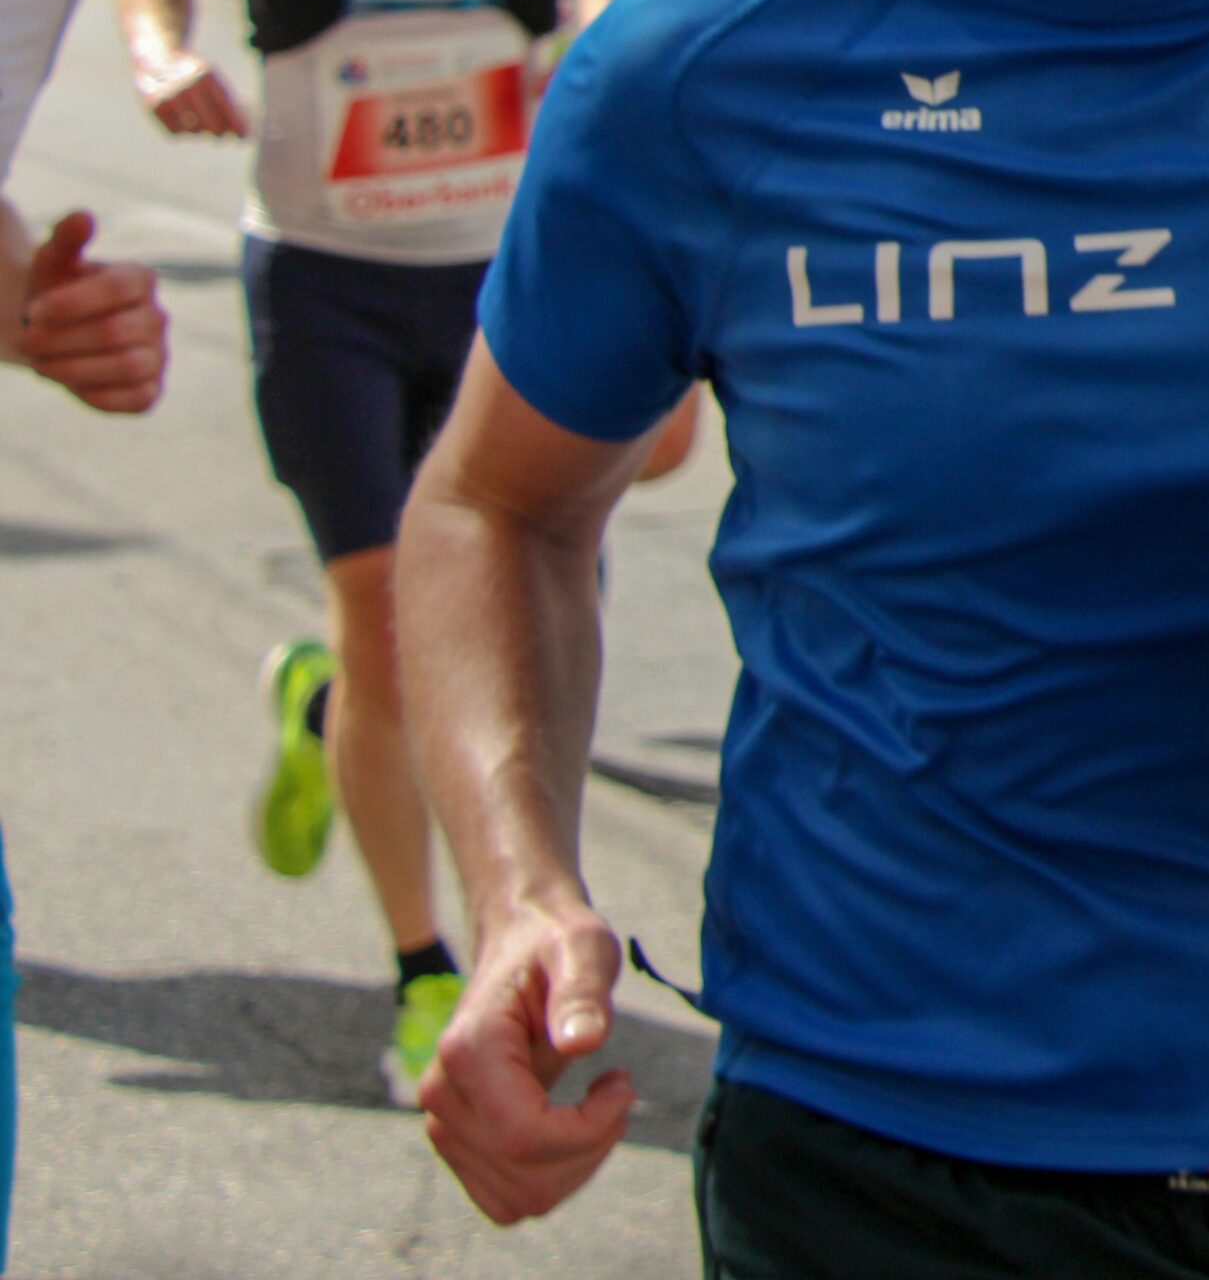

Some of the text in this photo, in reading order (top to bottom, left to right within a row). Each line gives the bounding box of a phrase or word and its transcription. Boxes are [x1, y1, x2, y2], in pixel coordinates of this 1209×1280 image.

[382, 106, 474, 150] 480
[881, 106, 982, 131] erima
[787, 228, 1175, 328] LINZ
